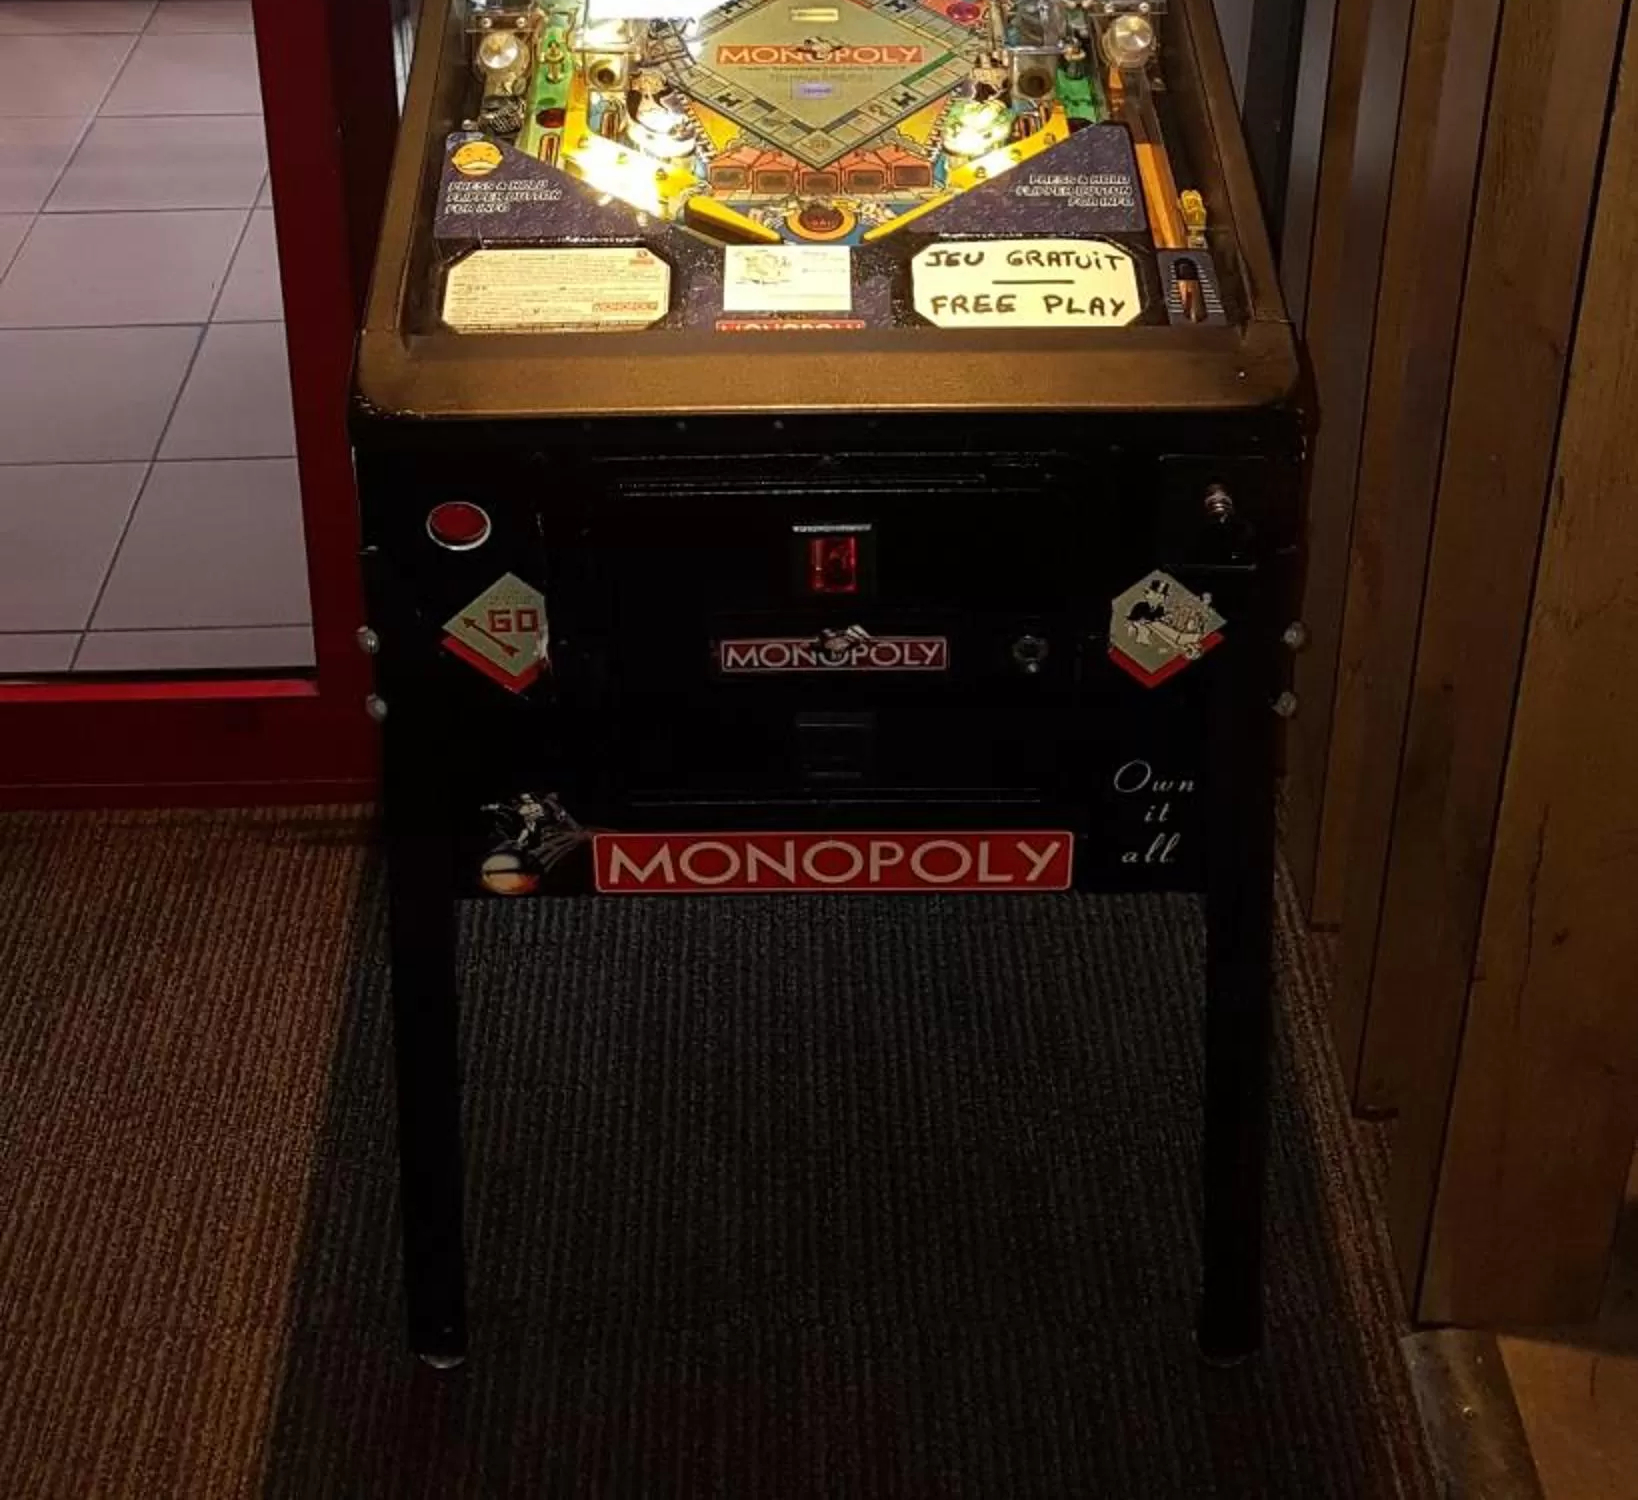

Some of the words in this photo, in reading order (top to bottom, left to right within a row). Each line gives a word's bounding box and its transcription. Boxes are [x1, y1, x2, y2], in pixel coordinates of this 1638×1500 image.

[719, 46, 919, 64] MONOPOLY
[925, 250, 985, 268] JEU
[930, 294, 1018, 315] FREE
[1042, 294, 1126, 316] PLAY
[487, 608, 539, 633] GO
[725, 641, 942, 669] MONOPOLY
[1113, 758, 1195, 793] Own
[1144, 802, 1170, 823] it
[1120, 832, 1181, 864] all
[608, 839, 1061, 885] MONOPOLY
